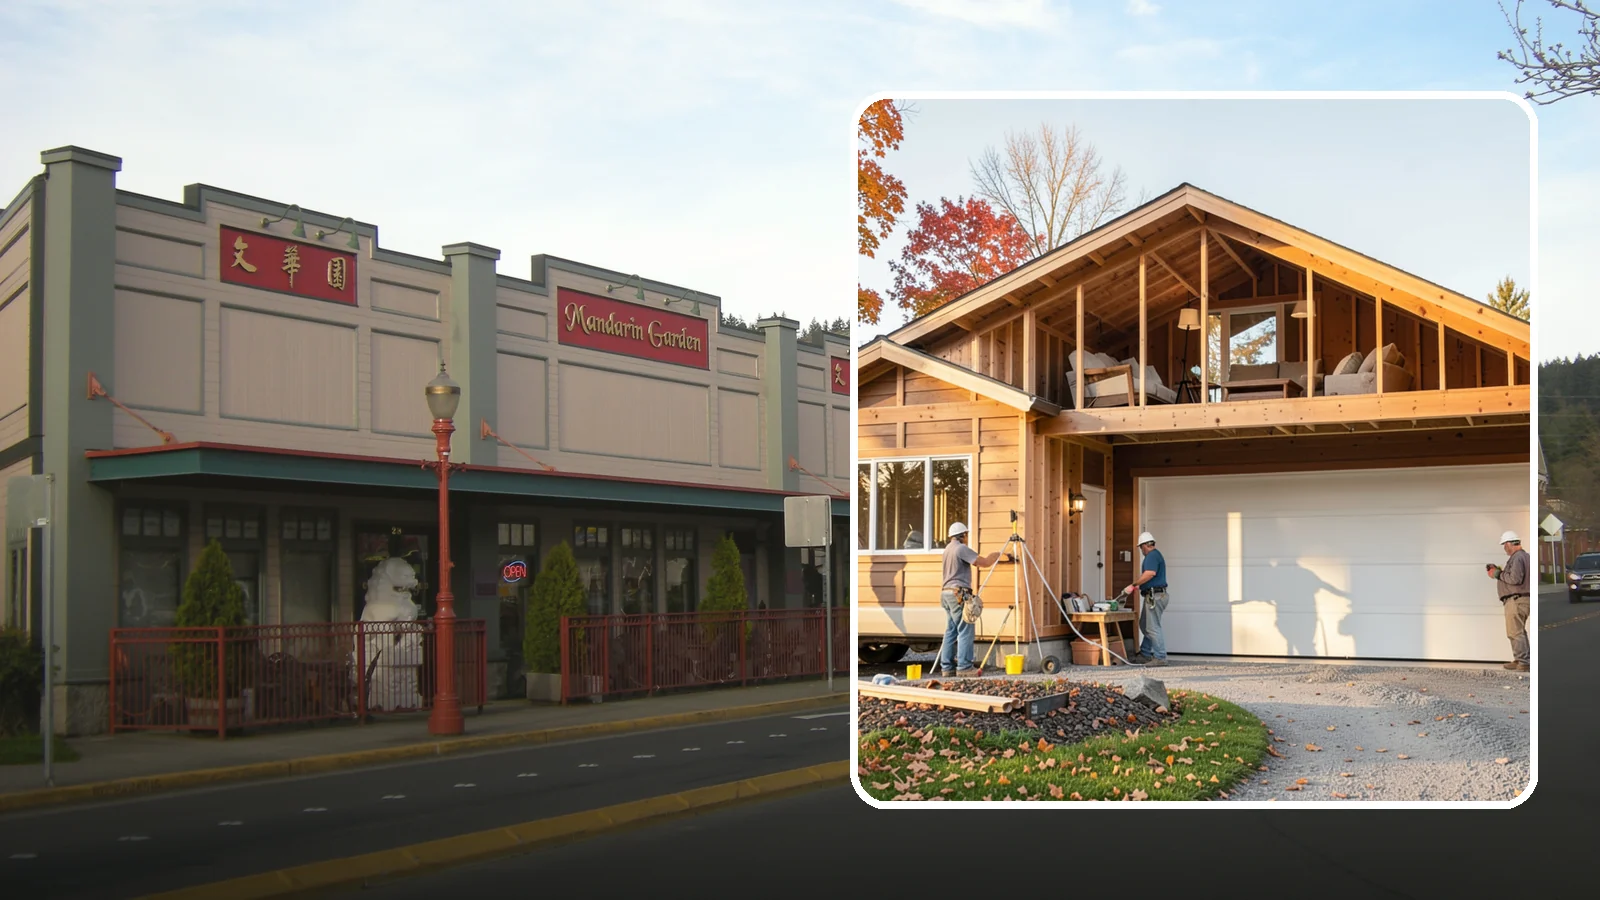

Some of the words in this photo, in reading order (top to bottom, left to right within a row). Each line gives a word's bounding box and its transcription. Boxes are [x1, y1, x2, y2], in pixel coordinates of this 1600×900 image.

[231, 236, 346, 291] 文華園
[565, 302, 644, 341] Mandarin
[647, 320, 702, 352] Garden
[834, 362, 846, 386] 文
[503, 565, 527, 578] OPEN
